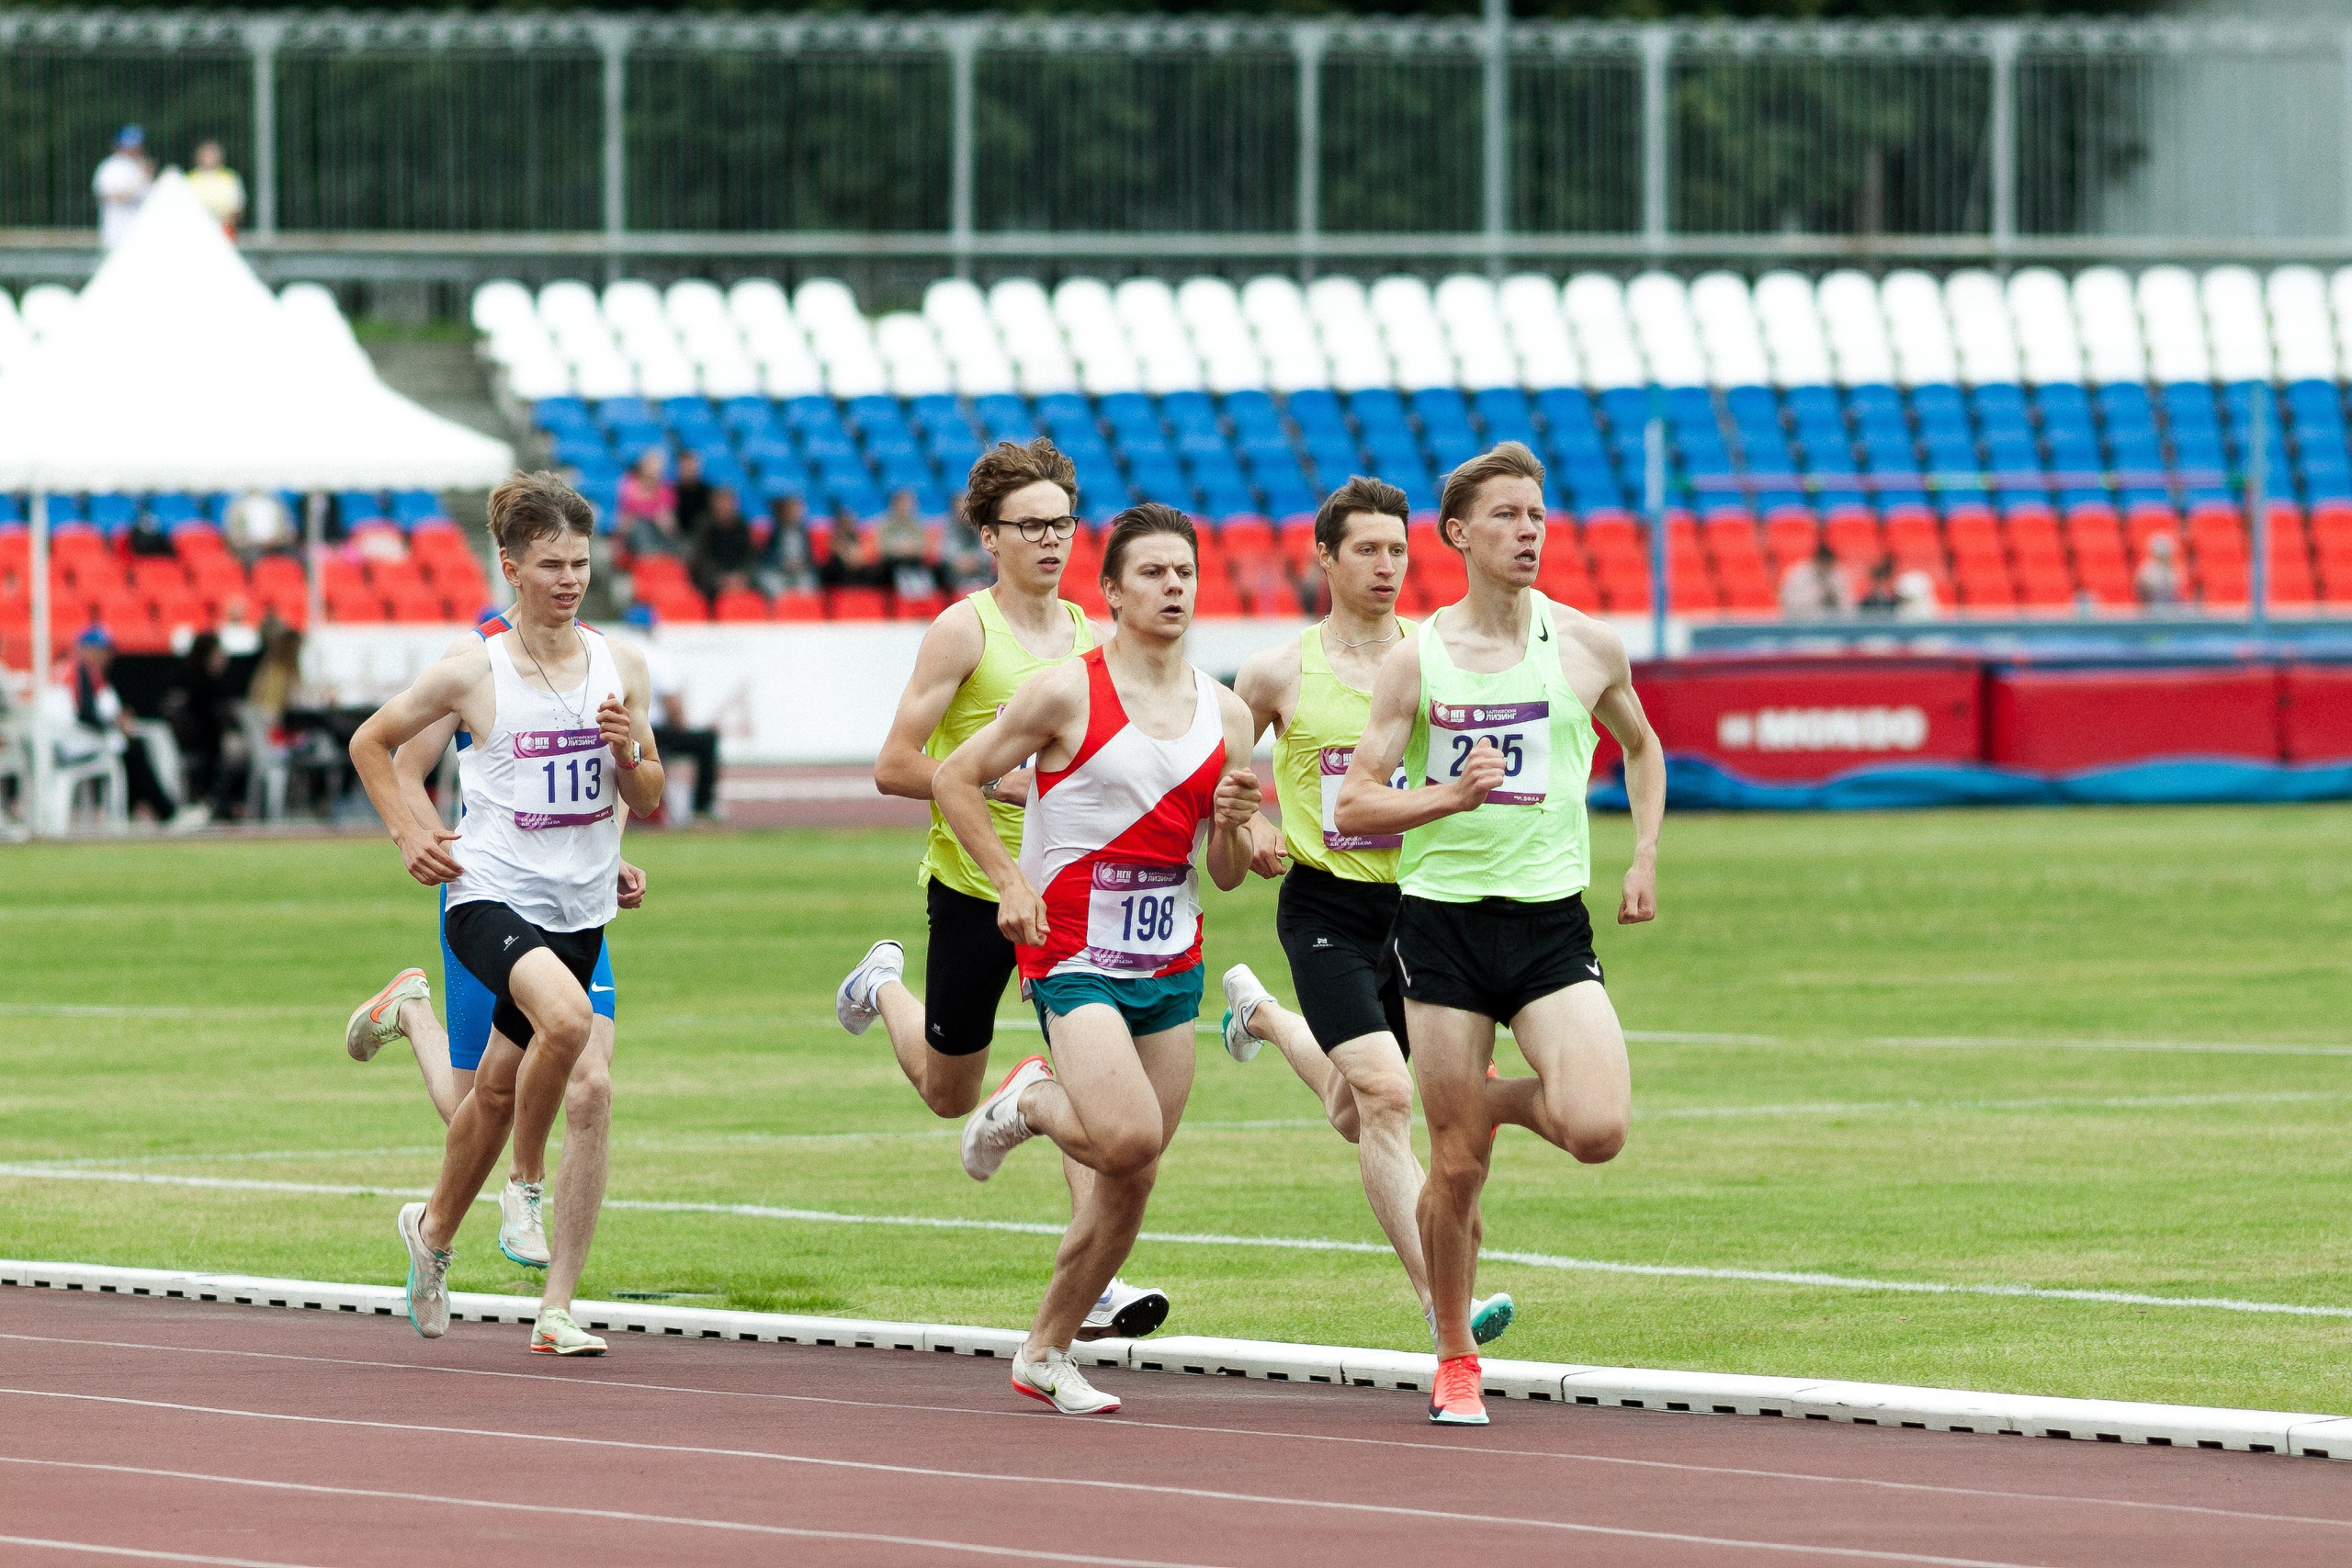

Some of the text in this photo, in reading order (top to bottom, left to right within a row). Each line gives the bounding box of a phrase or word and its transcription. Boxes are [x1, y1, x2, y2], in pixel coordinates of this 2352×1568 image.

[1486, 712, 1517, 721] ЛИЗИНГ
[567, 738, 597, 747] ЛИЗИНГ
[543, 758, 601, 803] 113
[1116, 870, 1132, 879] НГК
[1121, 896, 1175, 942] 198
